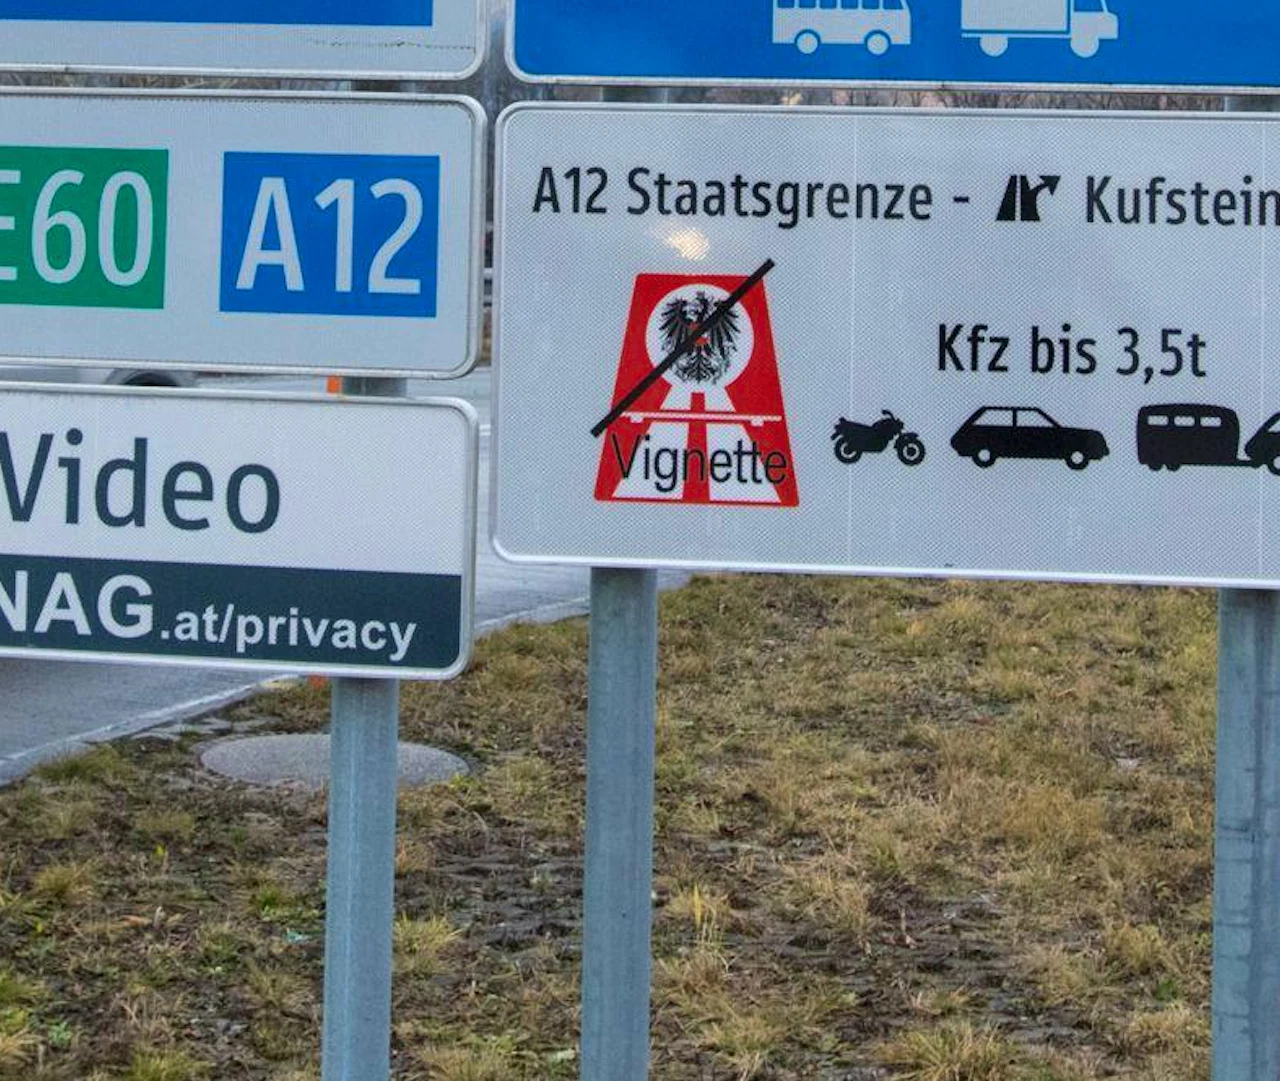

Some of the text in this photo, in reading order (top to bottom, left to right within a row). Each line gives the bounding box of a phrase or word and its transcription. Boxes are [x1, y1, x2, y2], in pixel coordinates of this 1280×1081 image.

[532, 166, 608, 215] A12
[627, 167, 933, 229] Staatsgrenze
[236, 177, 423, 294] A12
[938, 322, 1207, 385] Kfz bis 3,5t
[612, 433, 787, 492] Vignette
